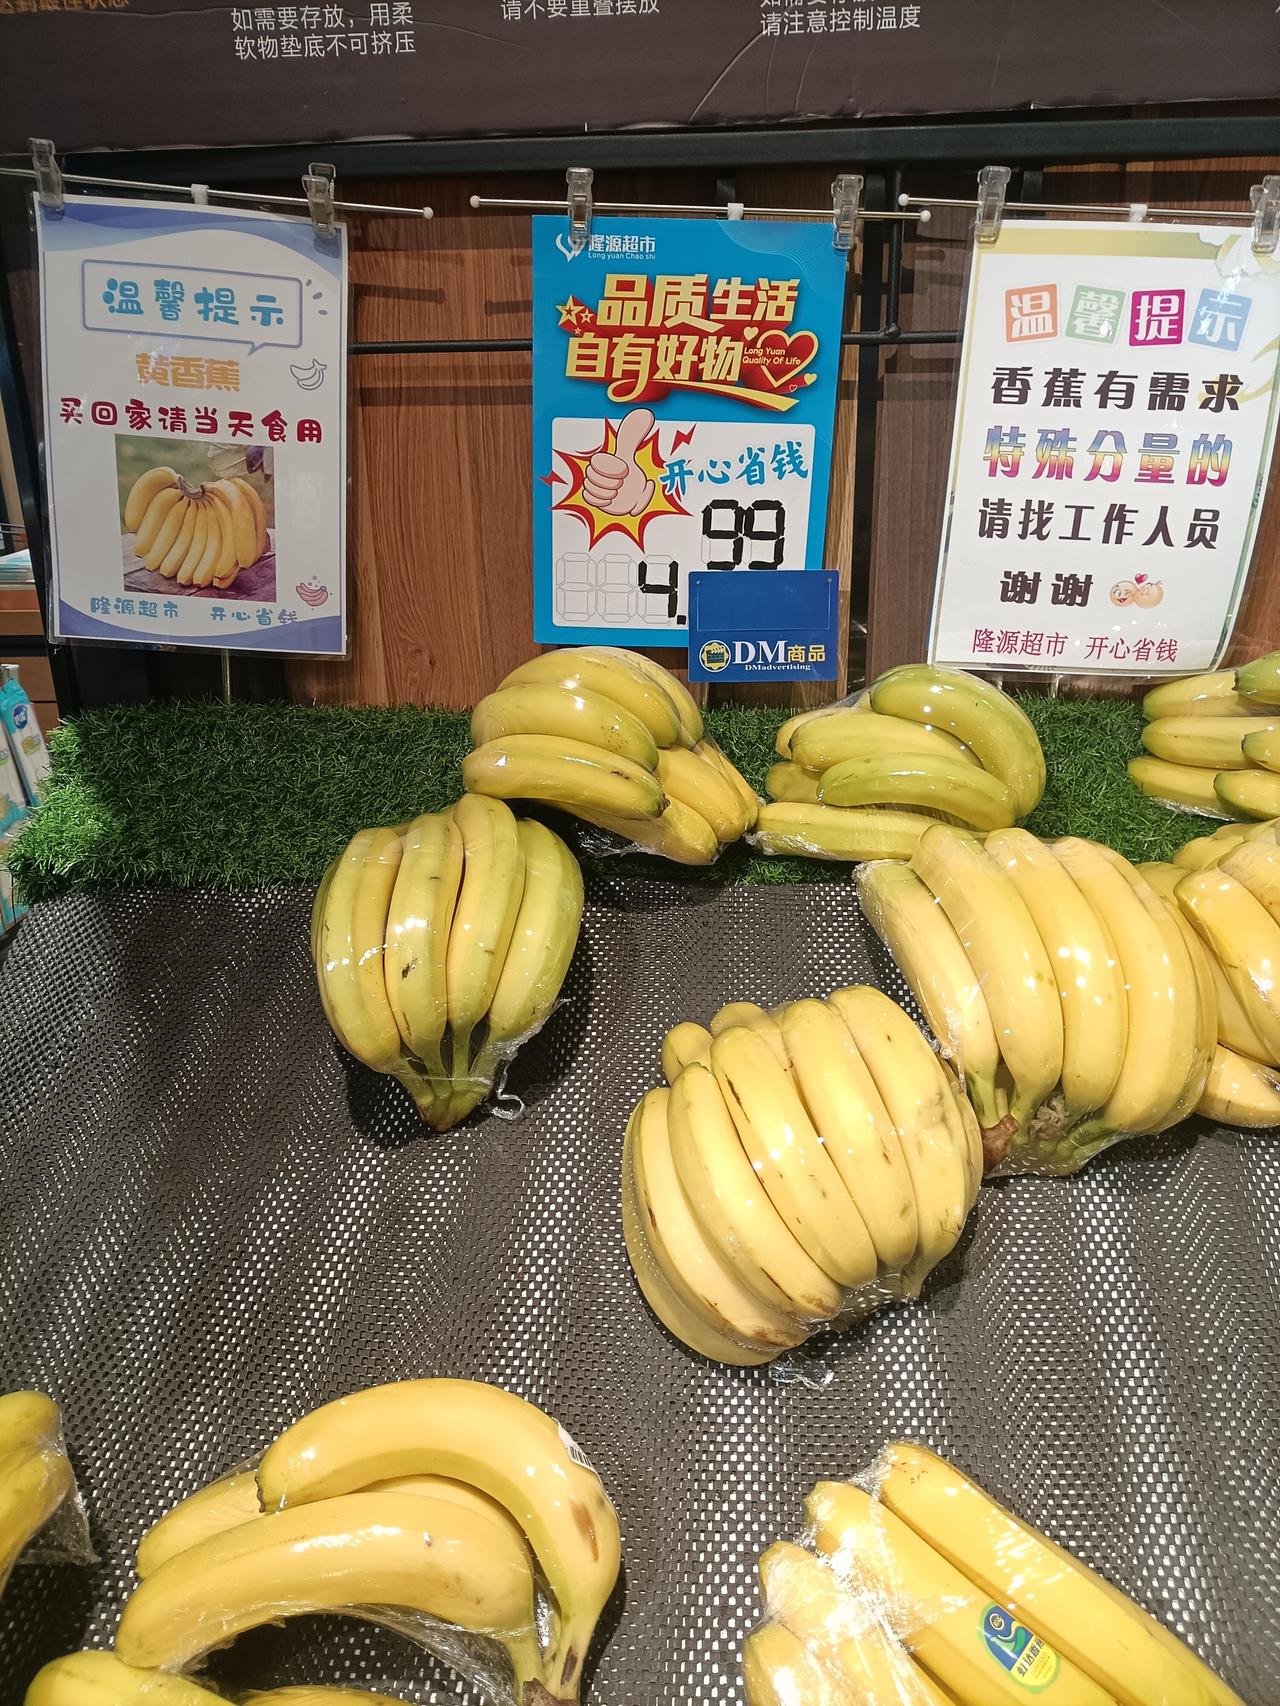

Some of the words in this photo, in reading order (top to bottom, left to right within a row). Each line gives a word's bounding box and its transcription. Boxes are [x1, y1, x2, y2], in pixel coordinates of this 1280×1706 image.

[231, 2, 413, 31] 如需要存放，用柔
[760, 4, 921, 36] 请注意控制温度
[234, 30, 416, 60] 软物垫底不可挤压
[102, 278, 285, 327] 温馨提示
[596, 273, 801, 333] 品质生活
[1008, 287, 1247, 346] 温馨提示
[565, 332, 744, 401] 自有好物
[742, 356, 772, 365] Quality
[773, 357, 785, 365] Of
[785, 357, 801, 365] Life
[744, 347, 764, 356] Long
[766, 347, 786, 355] Yuan
[135, 352, 241, 392] 黄香蕉
[990, 366, 1243, 413] 香蕉有需求
[59, 397, 323, 443] 买回家请当天食用
[660, 441, 809, 496] 开心省钱
[982, 425, 1233, 487] 特殊分量的
[977, 498, 1220, 549] 请找工作人员
[999, 570, 1093, 607] 谢谢
[90, 596, 179, 619] 隆源超市
[210, 606, 298, 626] 开心省钱
[732, 640, 826, 664] DM商品
[972, 628, 1069, 657] 隆源超市
[1084, 635, 1178, 663] 开心省钱
